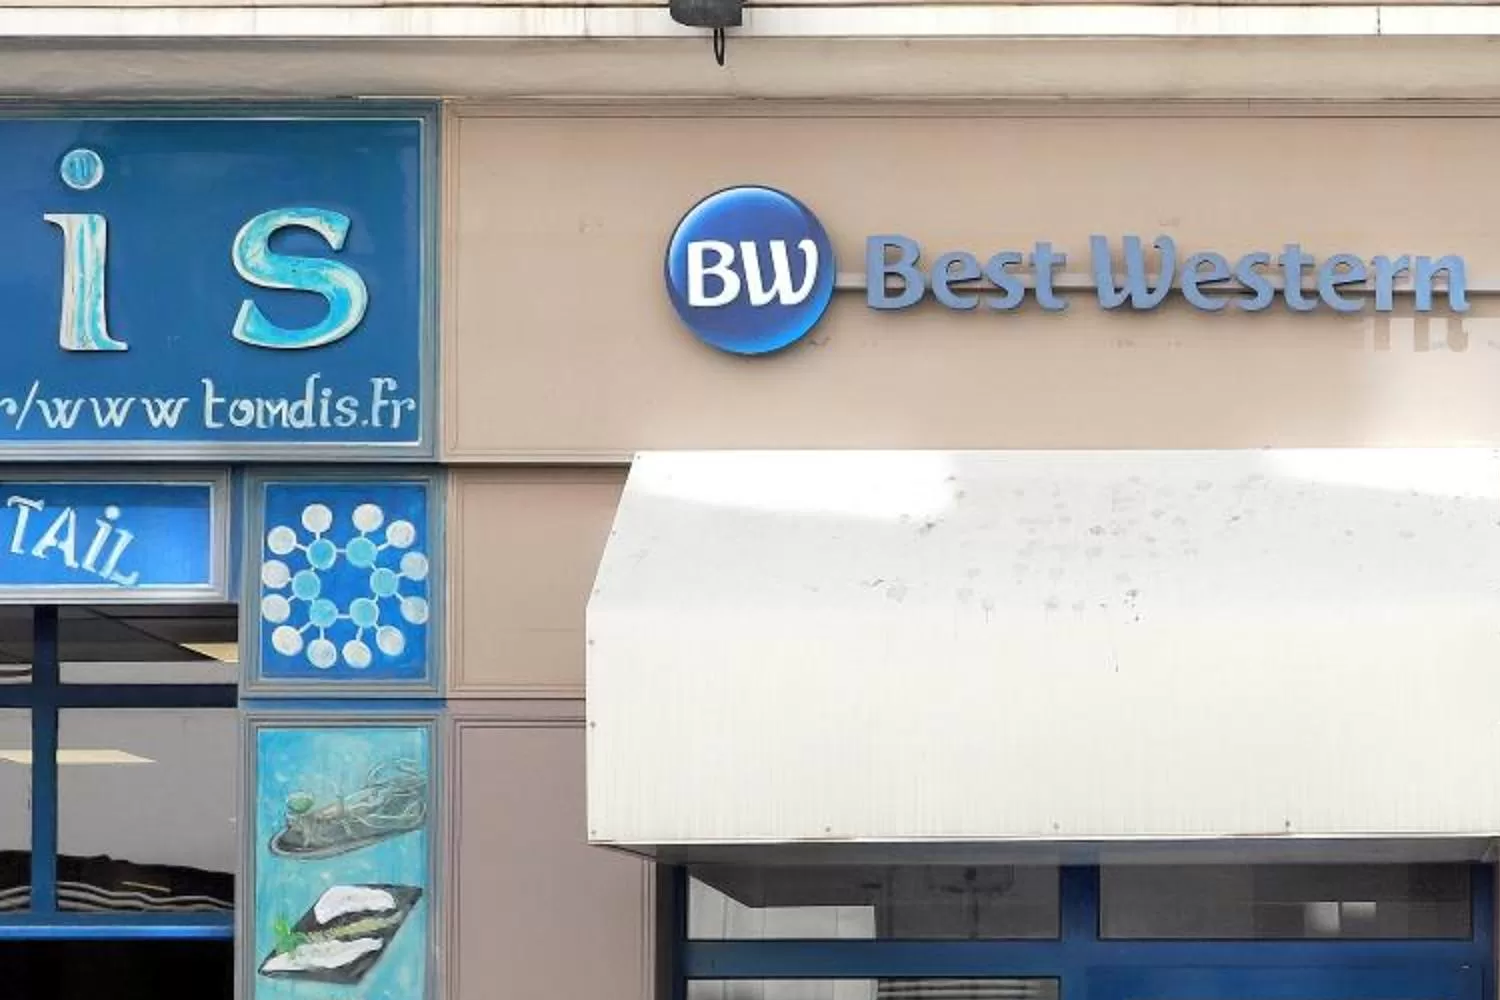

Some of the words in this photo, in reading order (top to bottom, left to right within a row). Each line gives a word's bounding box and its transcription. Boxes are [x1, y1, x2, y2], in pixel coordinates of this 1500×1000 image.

[686, 238, 818, 307] BW
[865, 234, 1068, 312] Best
[1089, 234, 1470, 313] Western
[201, 372, 416, 428] tomdis.fr
